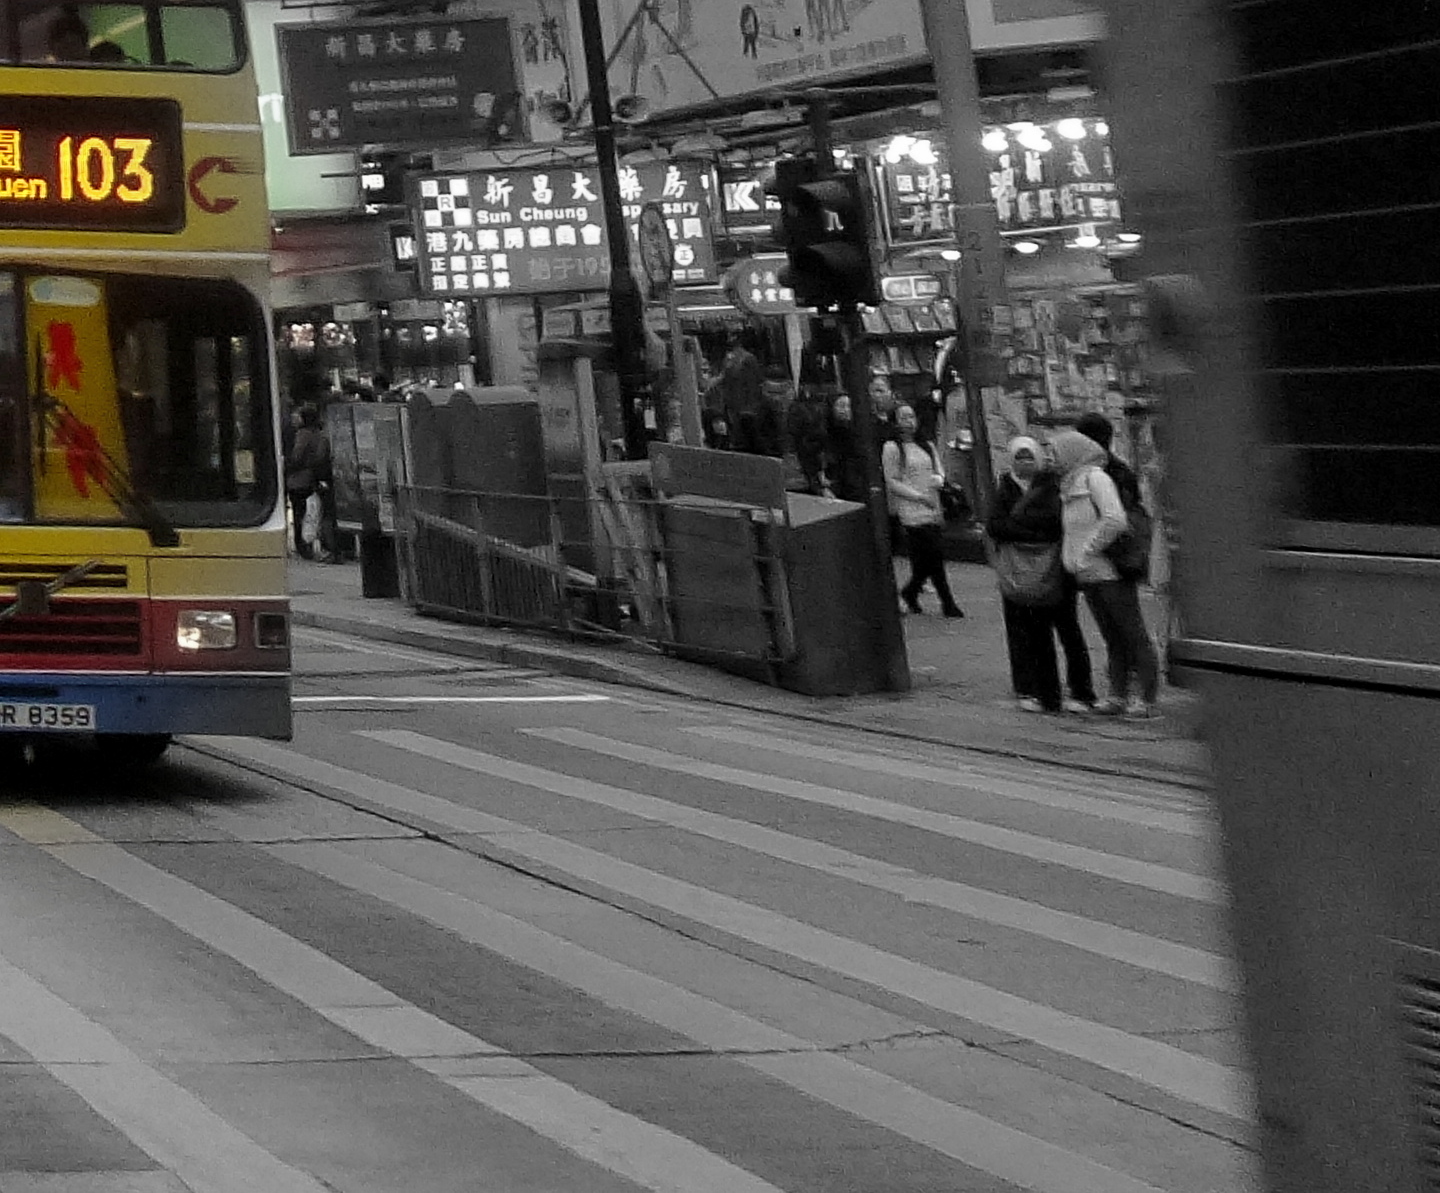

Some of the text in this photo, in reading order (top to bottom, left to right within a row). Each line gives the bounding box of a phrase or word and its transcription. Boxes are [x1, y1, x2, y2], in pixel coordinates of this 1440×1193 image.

[58, 136, 154, 202] 103
[476, 209, 512, 224] Sun
[519, 207, 589, 222] Cheung
[28, 705, 90, 726] 8359
